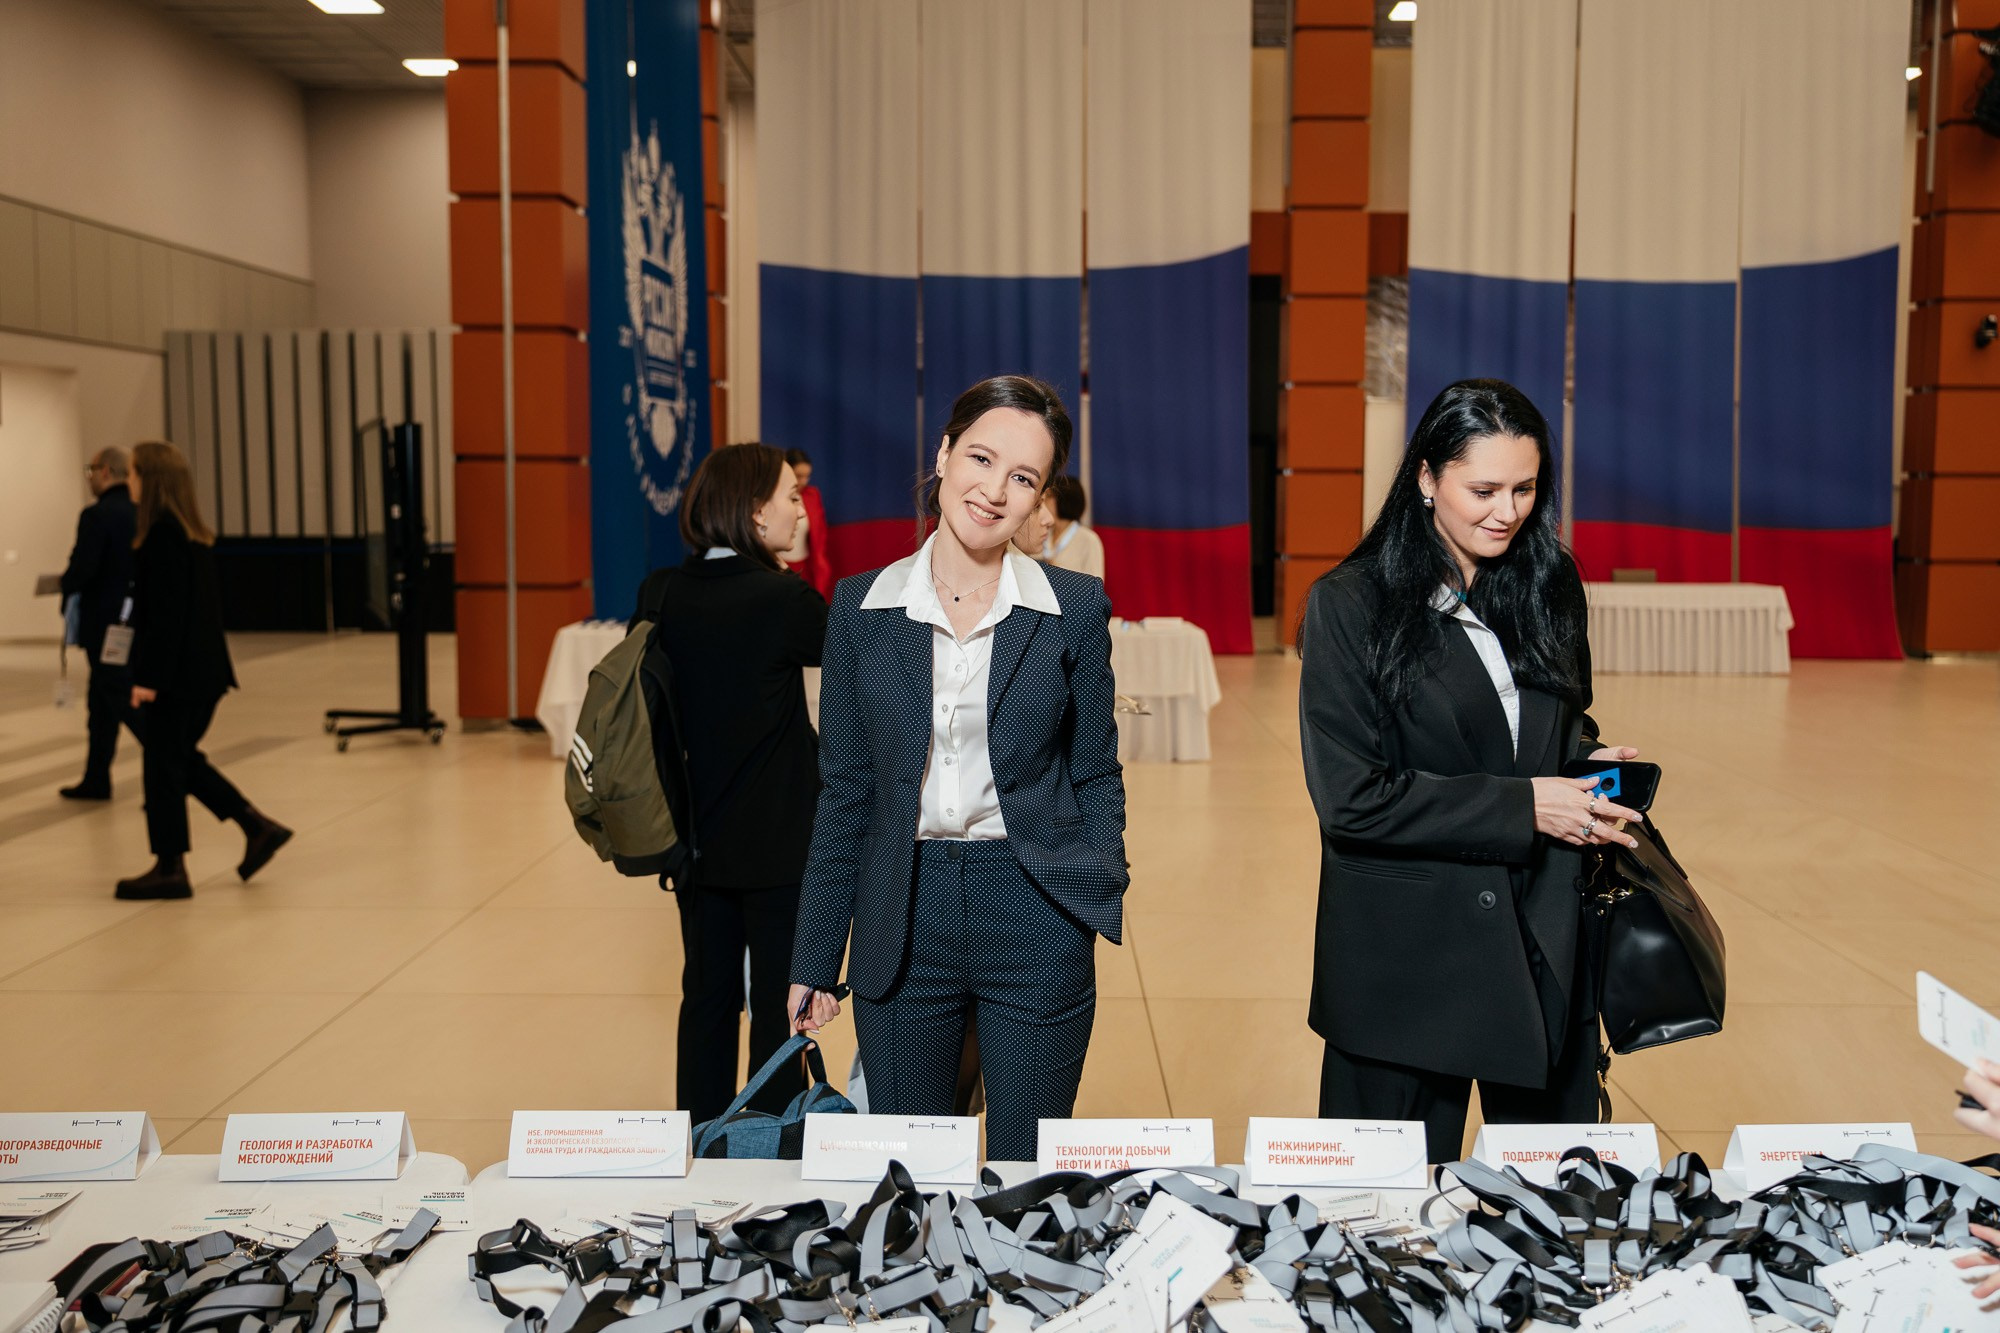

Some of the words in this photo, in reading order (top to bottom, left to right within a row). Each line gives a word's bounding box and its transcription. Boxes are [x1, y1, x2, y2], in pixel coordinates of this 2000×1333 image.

[239, 1140, 292, 1151] ГЕОЛОГИЯ
[295, 1139, 303, 1149] И
[305, 1138, 373, 1150] РАЗРАБОТКА
[584, 1147, 636, 1155] ГРАЖДАНСКАЯ
[636, 1147, 666, 1155] ЗАЩИТА
[1056, 1146, 1123, 1156] ТЕХНОЛОГИИ
[1125, 1146, 1171, 1157] ДОБЫЧИ
[1502, 1151, 1563, 1163] ПОДДЕРЖК
[237, 1151, 334, 1165] МЕСТОРОЖДЕНИЙ
[1268, 1154, 1355, 1166] РЕИНЖИНИРИНГ
[1056, 1159, 1091, 1170] НЕФТИ
[1094, 1159, 1101, 1170] И
[1104, 1159, 1130, 1170] ГАЗА
